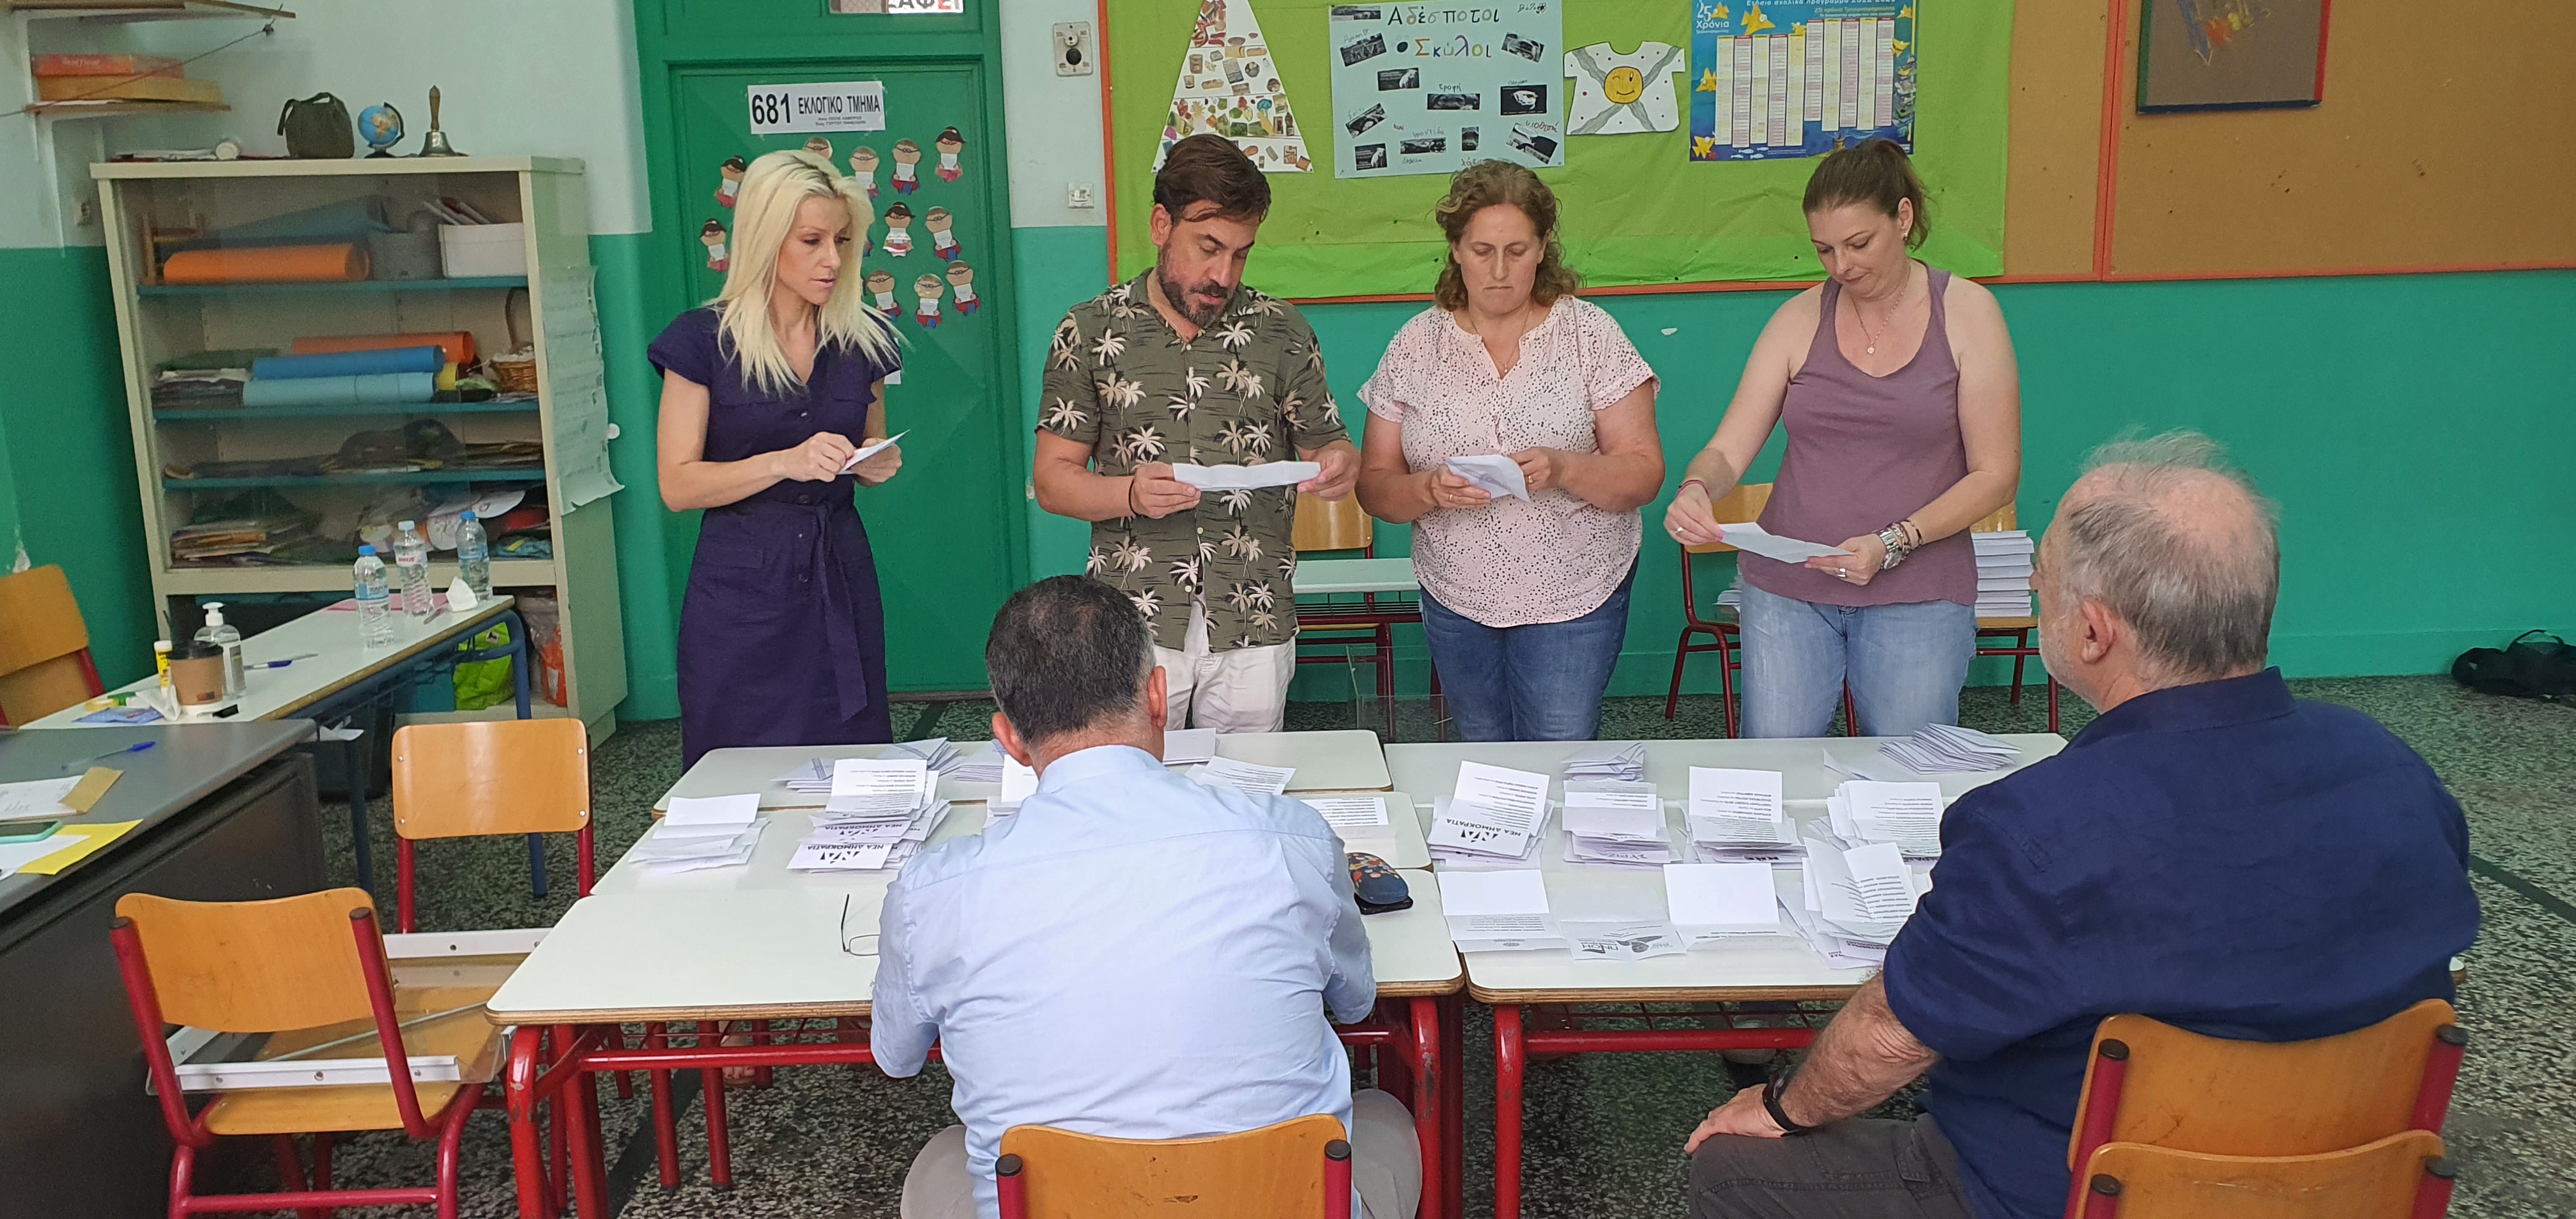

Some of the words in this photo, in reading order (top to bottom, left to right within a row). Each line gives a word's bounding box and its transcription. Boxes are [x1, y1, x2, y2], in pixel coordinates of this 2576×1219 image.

[1388, 6, 1499, 26] Αδέσποτοι
[1697, 0, 1712, 22] 25
[1696, 20, 1729, 31] Χρόνια
[1414, 34, 1492, 58] Σκύλοι
[752, 93, 790, 125] 681
[798, 96, 843, 114] ΕΚΛΟΓΙΚΟ
[847, 95, 880, 112] ΤΜΗΜΑ
[1446, 818, 1501, 833] ΔΗΜΟΚΡΑΤΙΑ
[1504, 829, 1521, 837] ΝΕΑ
